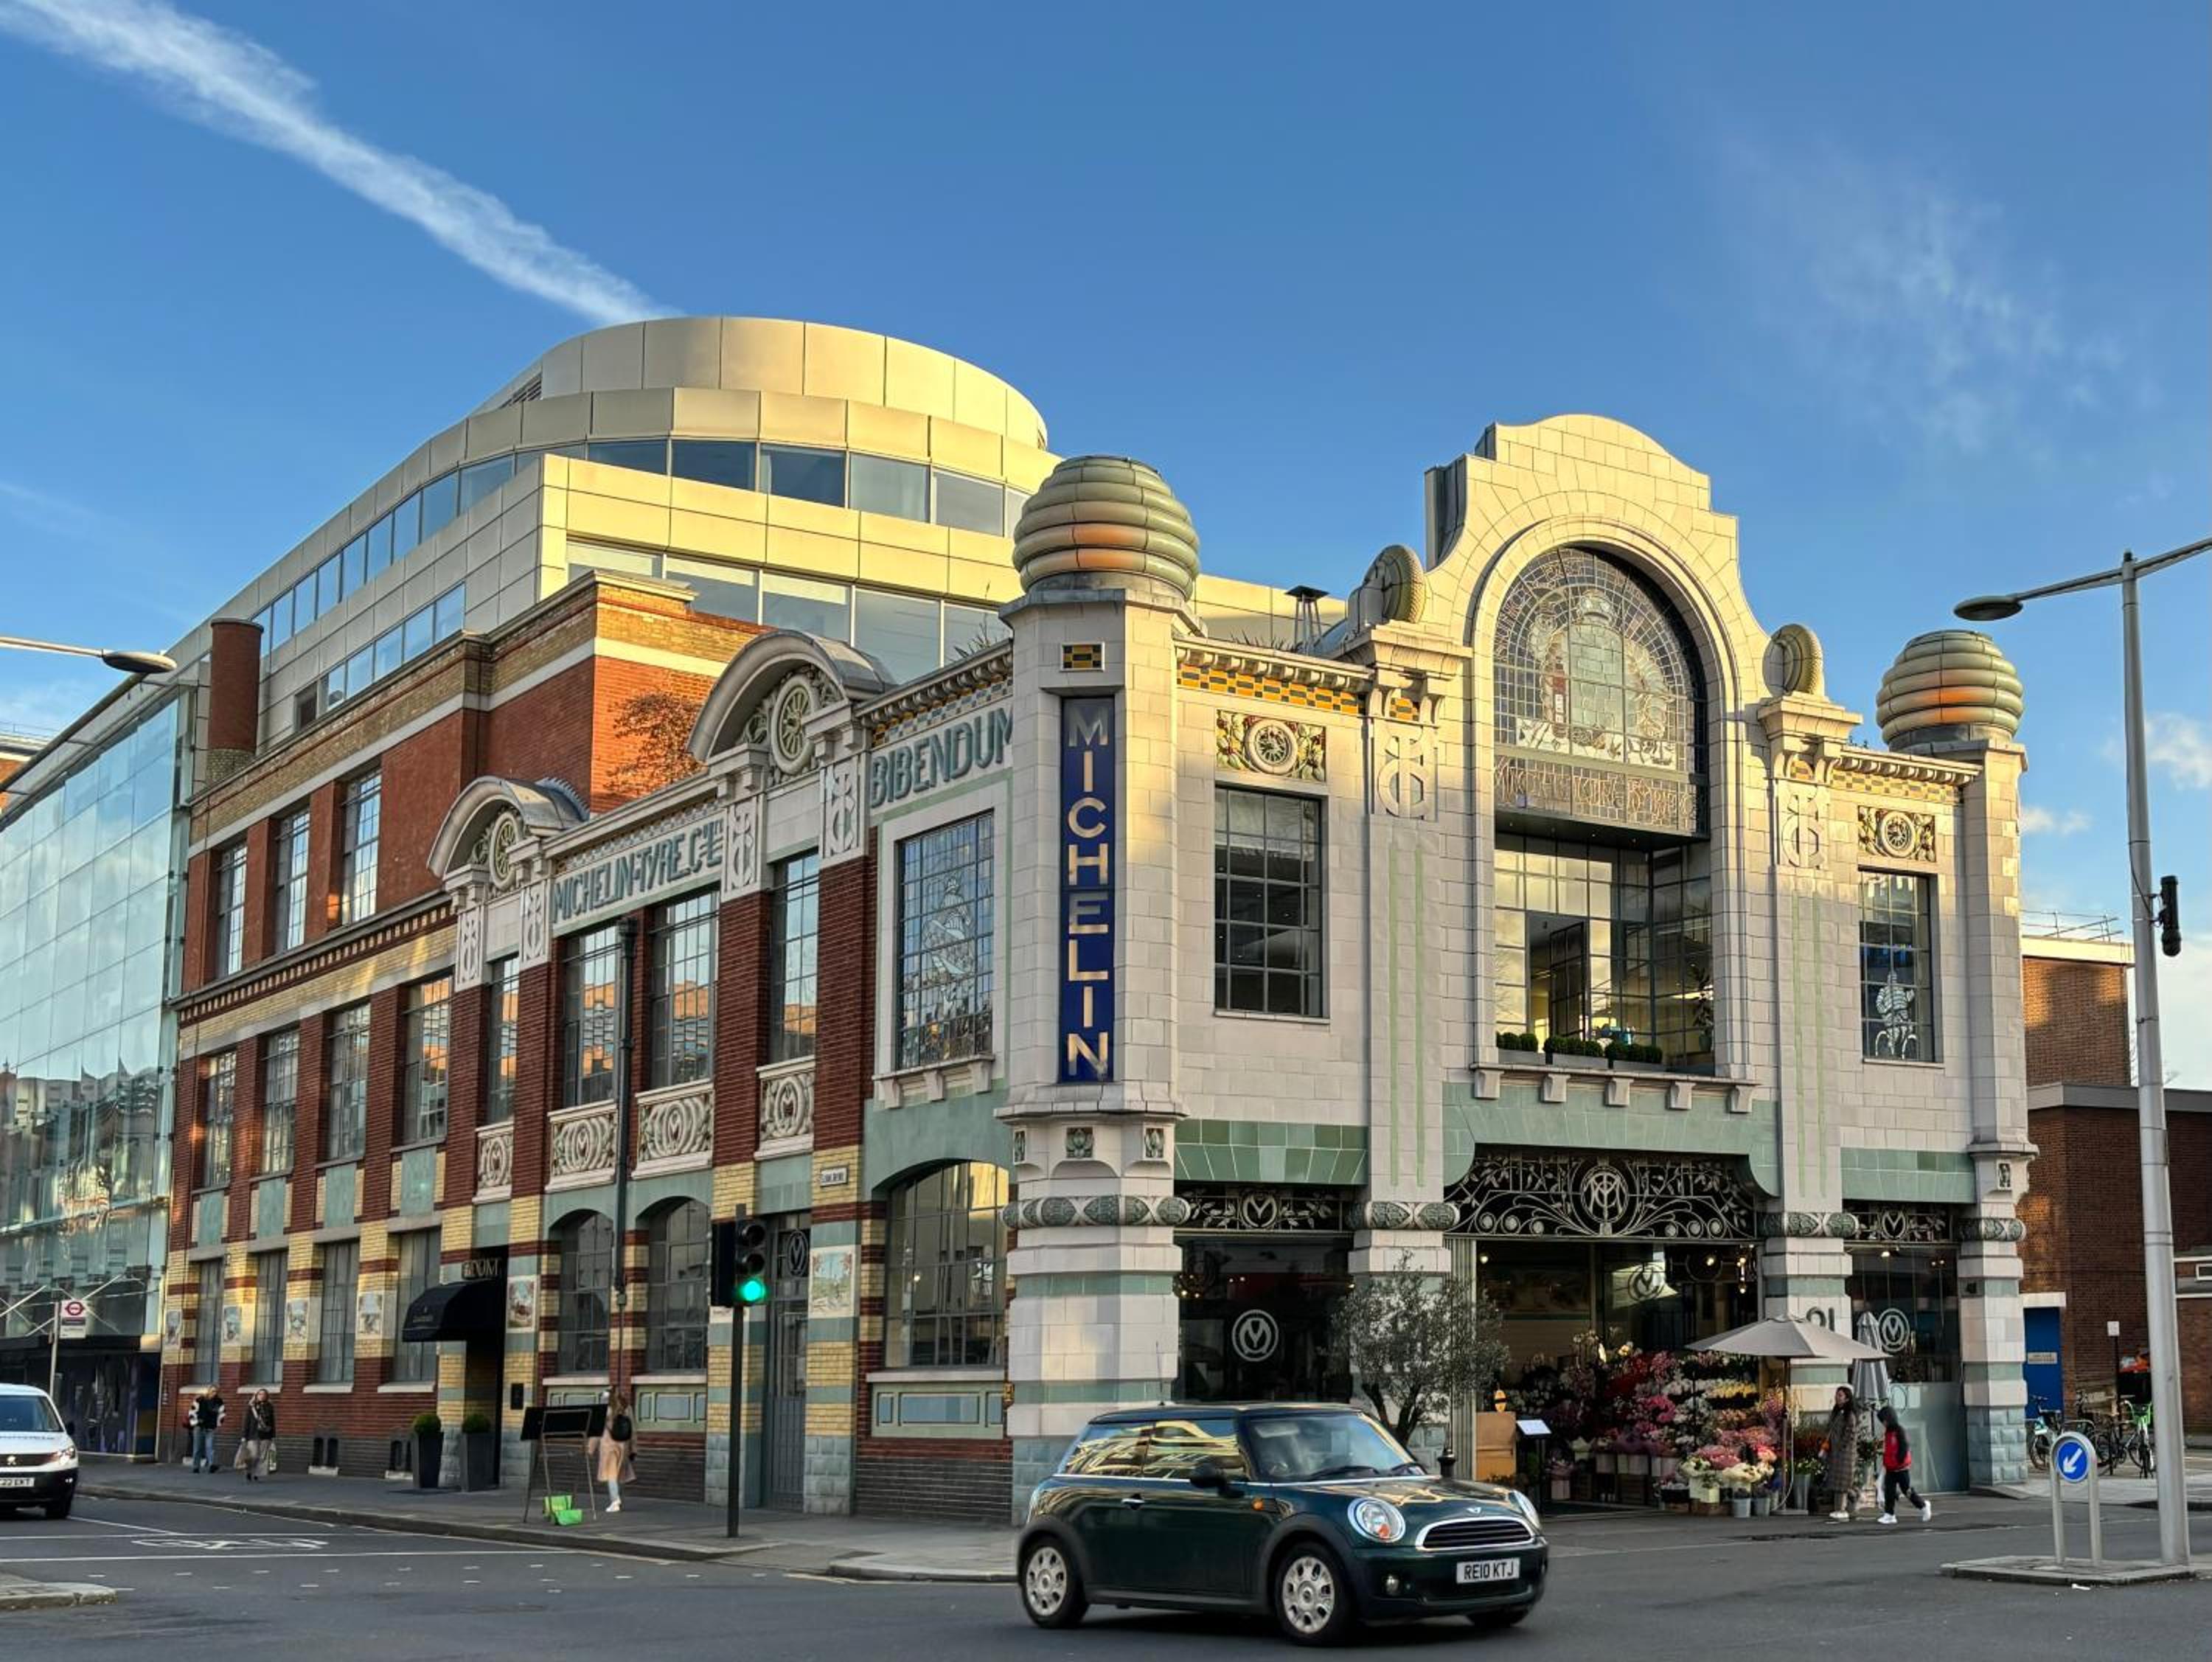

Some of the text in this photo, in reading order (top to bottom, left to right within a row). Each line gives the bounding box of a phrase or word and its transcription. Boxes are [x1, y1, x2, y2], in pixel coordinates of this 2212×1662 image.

[870, 703, 1014, 809] BIBENDUM
[1067, 705, 1110, 1082] MICHELIN
[1464, 1560, 1514, 1579] RE10 KTJ
